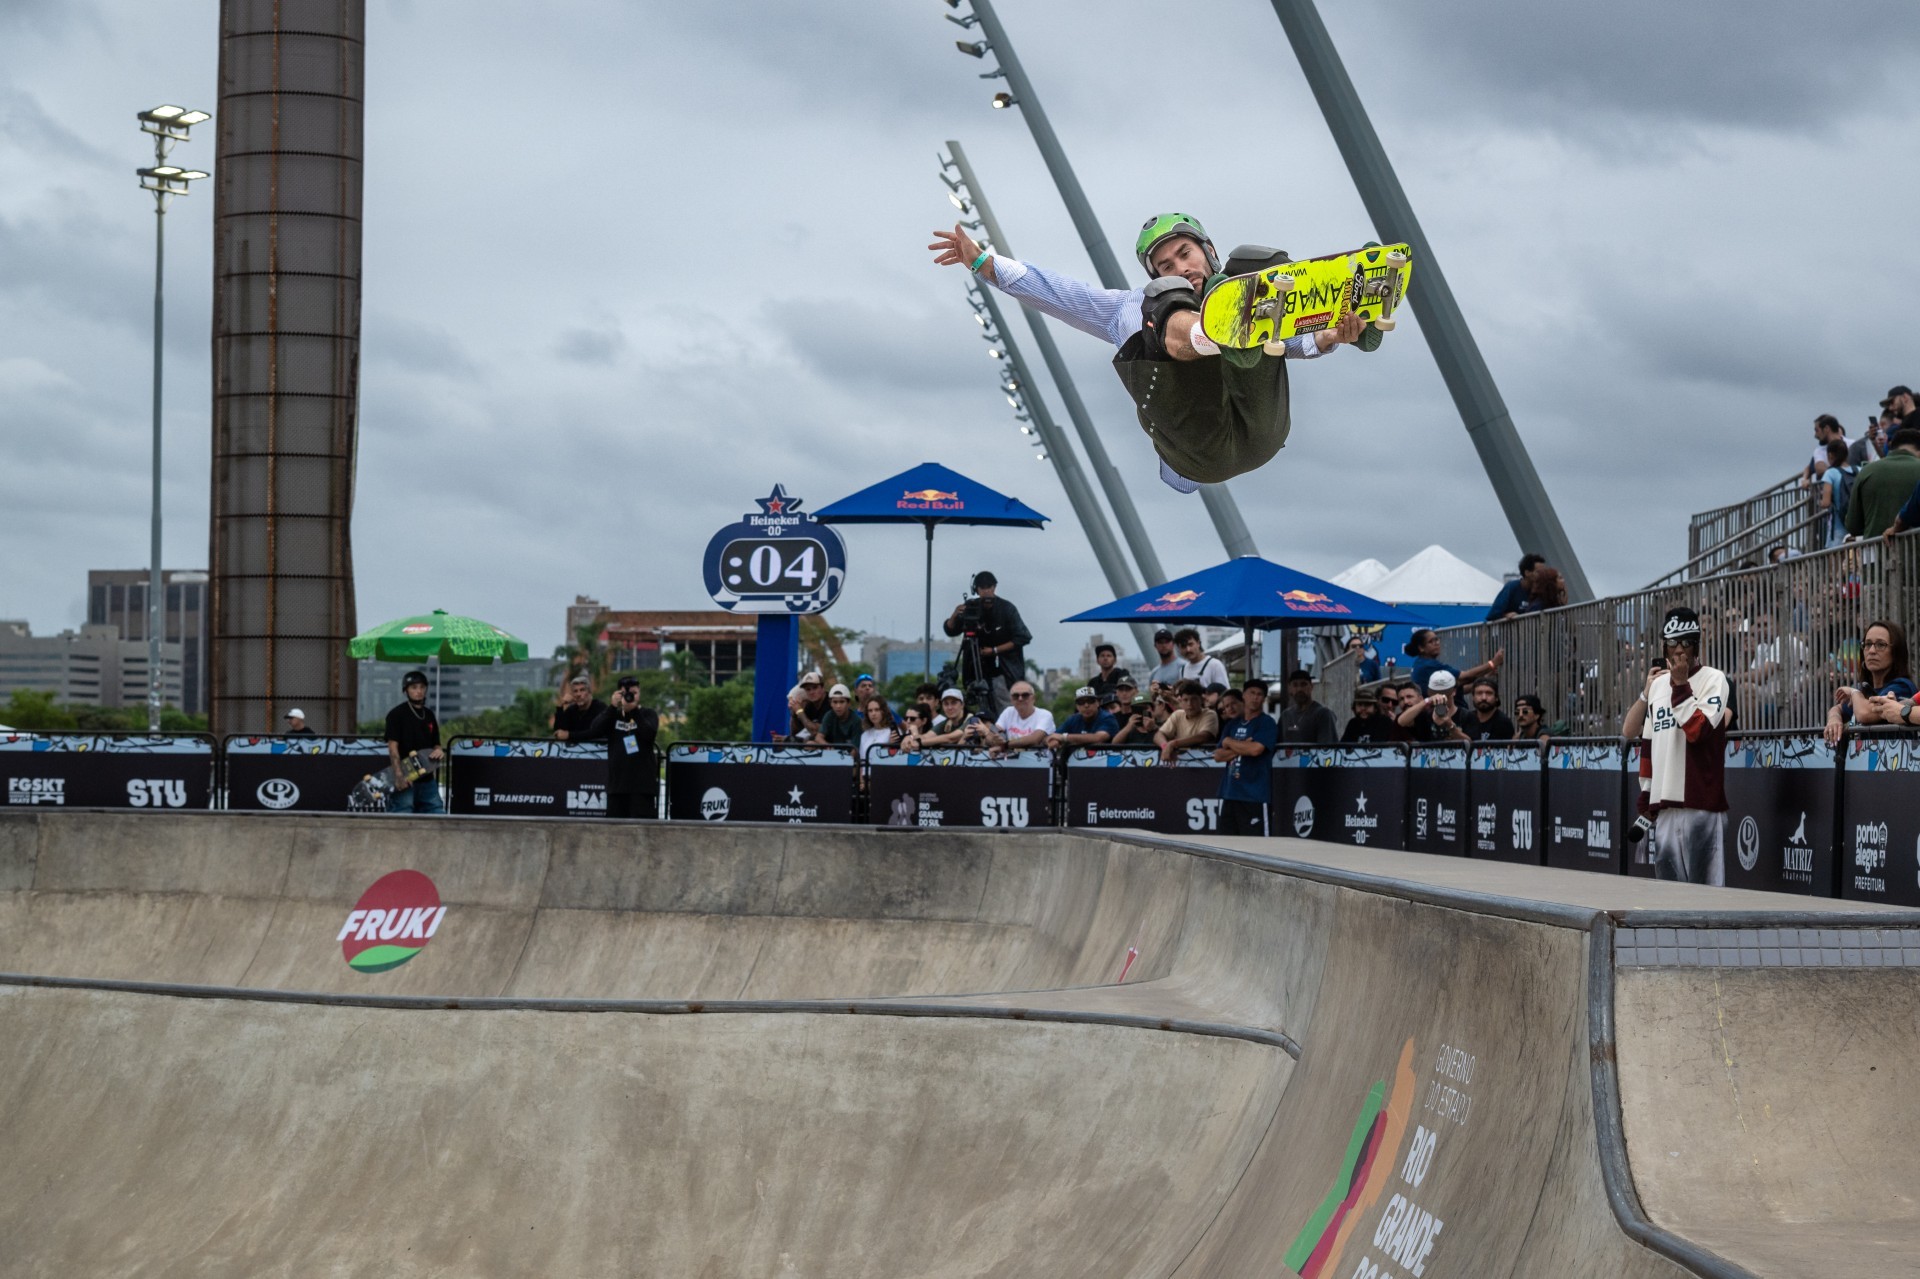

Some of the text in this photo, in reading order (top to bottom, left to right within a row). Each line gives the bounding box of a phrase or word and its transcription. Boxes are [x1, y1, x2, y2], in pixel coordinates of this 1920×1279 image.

[1352, 274, 1364, 303] Ford
[896, 500, 965, 510] Red Bull
[750, 515, 800, 526] Heineken
[9, 777, 66, 792] FGSKT
[126, 778, 187, 807] STU
[493, 793, 555, 804] TRANSPETRO
[701, 798, 731, 813] FRUKI
[773, 804, 818, 817] Heineken
[919, 810, 944, 819] GRANDE
[980, 796, 1030, 828] STU
[1186, 797, 1224, 831] ST
[1293, 807, 1315, 826] FRUKI
[1345, 814, 1378, 828] Heineken
[1637, 818, 1650, 829] STU
[1512, 809, 1532, 850] STU
[1561, 826, 1584, 839] TRANSPETRO
[1588, 819, 1611, 849] BRASIL
[1856, 821, 1878, 848] porto
[1783, 847, 1813, 872] MATRIZ
[1855, 843, 1878, 874] alegre
[1855, 875, 1886, 893] PREFEITURA
[336, 906, 448, 941] FRUKI
[1435, 1043, 1476, 1085] GOVERNO
[1424, 1080, 1472, 1126] DO ESTADO
[1400, 1125, 1437, 1188] RIO
[1373, 1192, 1444, 1279] GRANDE
